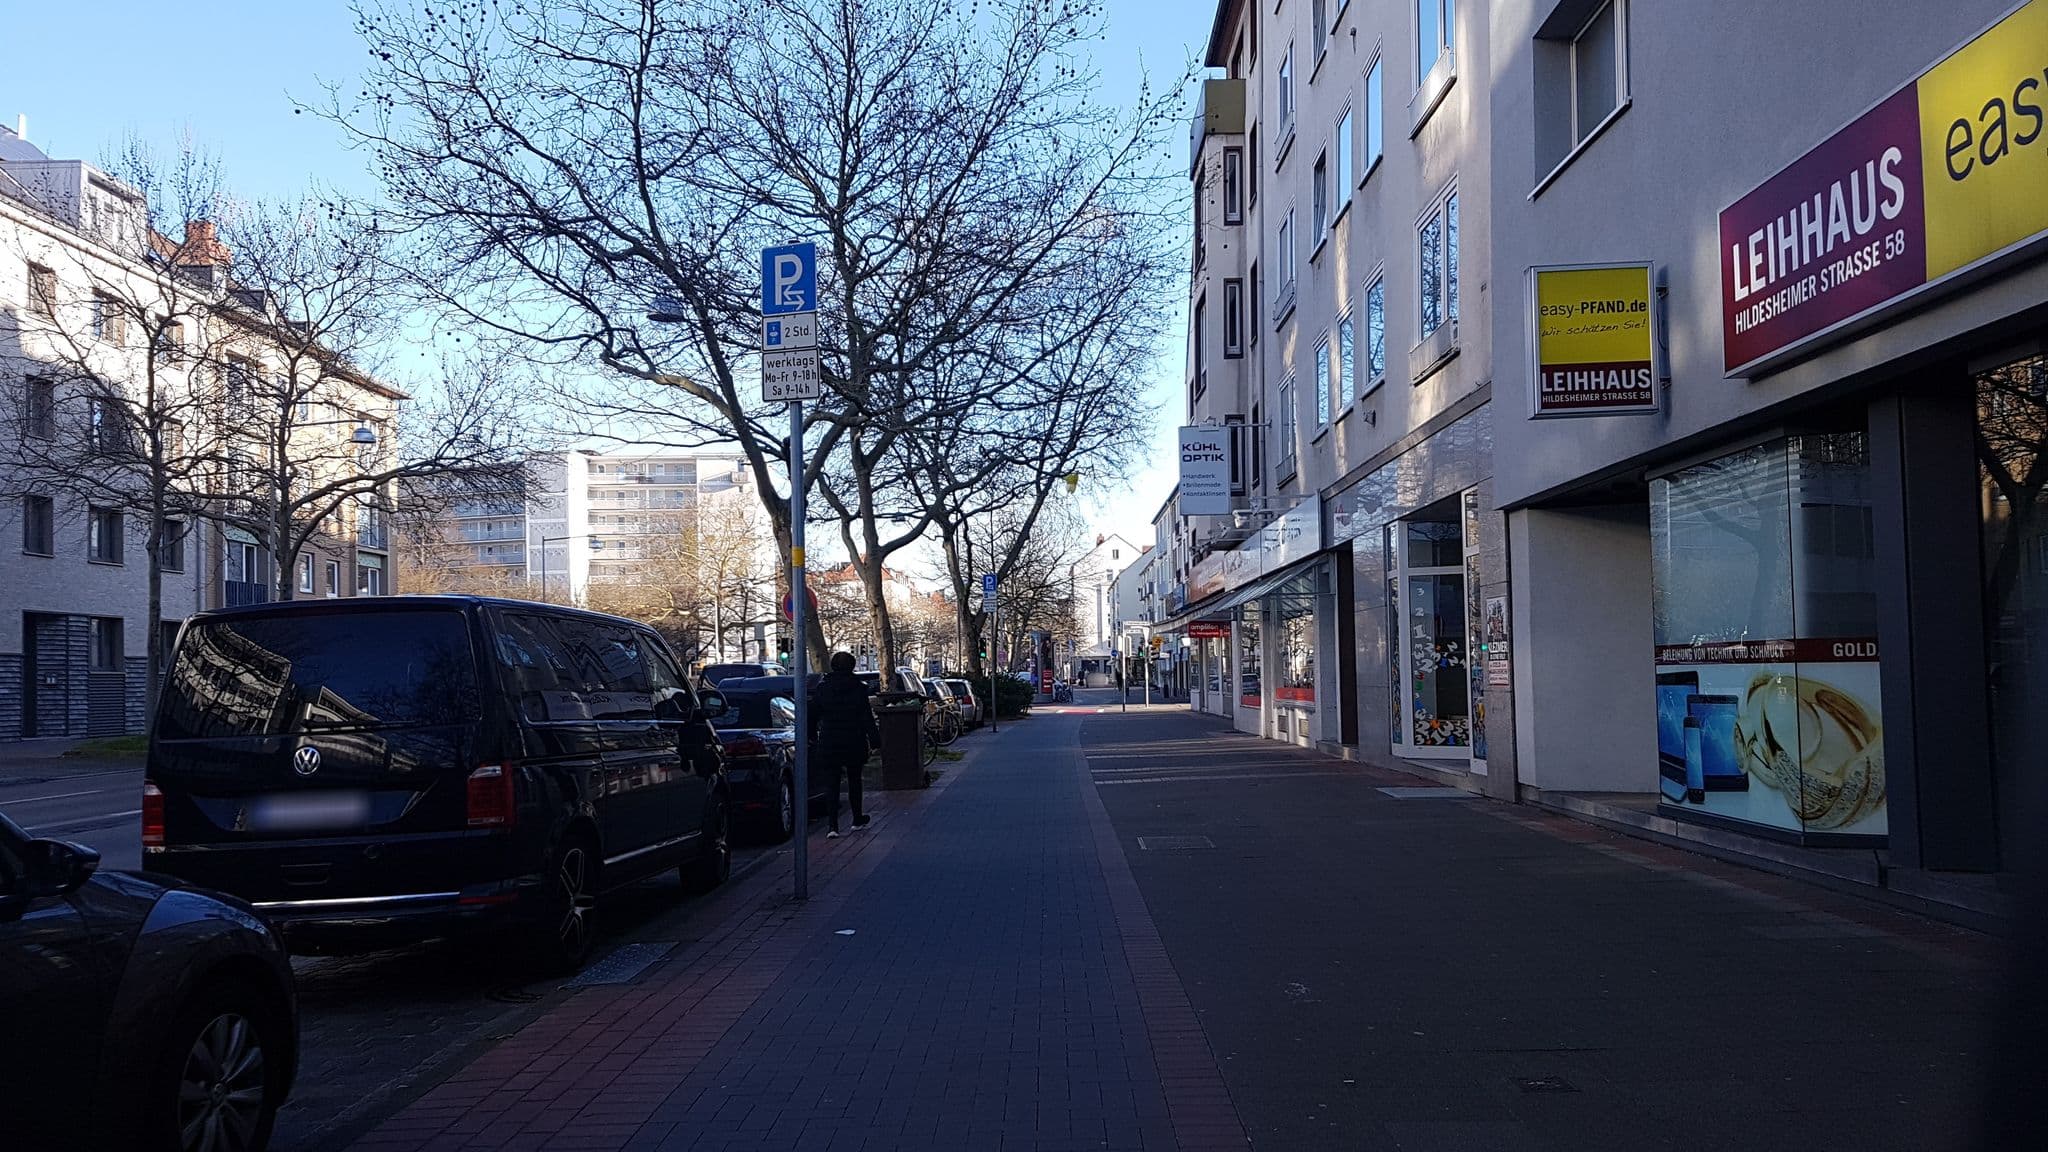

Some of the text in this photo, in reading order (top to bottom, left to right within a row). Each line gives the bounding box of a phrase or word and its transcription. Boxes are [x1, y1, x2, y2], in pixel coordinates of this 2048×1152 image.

[1945, 67, 2048, 182] eas
[1732, 147, 1905, 302] LEIHHAUS
[774, 254, 802, 305] P
[1735, 229, 1905, 335] HILDESHEIMER STRASSE 58
[1540, 299, 1647, 319] easy-PFAND.de
[1623, 318, 1647, 329] Sie!
[784, 327, 790, 338] 2
[766, 356, 815, 369] werktags
[765, 372, 789, 383] Mo-Fr
[1541, 368, 1651, 392] LEIHHAUS
[772, 385, 782, 396] Sa
[1542, 391, 1651, 403] HILDESHEIMER STRASSE 58
[1182, 441, 1221, 451] KÜHL
[1182, 454, 1225, 462] OPTIK
[1695, 647, 1706, 660] VON
[1707, 646, 1732, 660] TECHNIK
[1750, 644, 1784, 658] SCHMUCK
